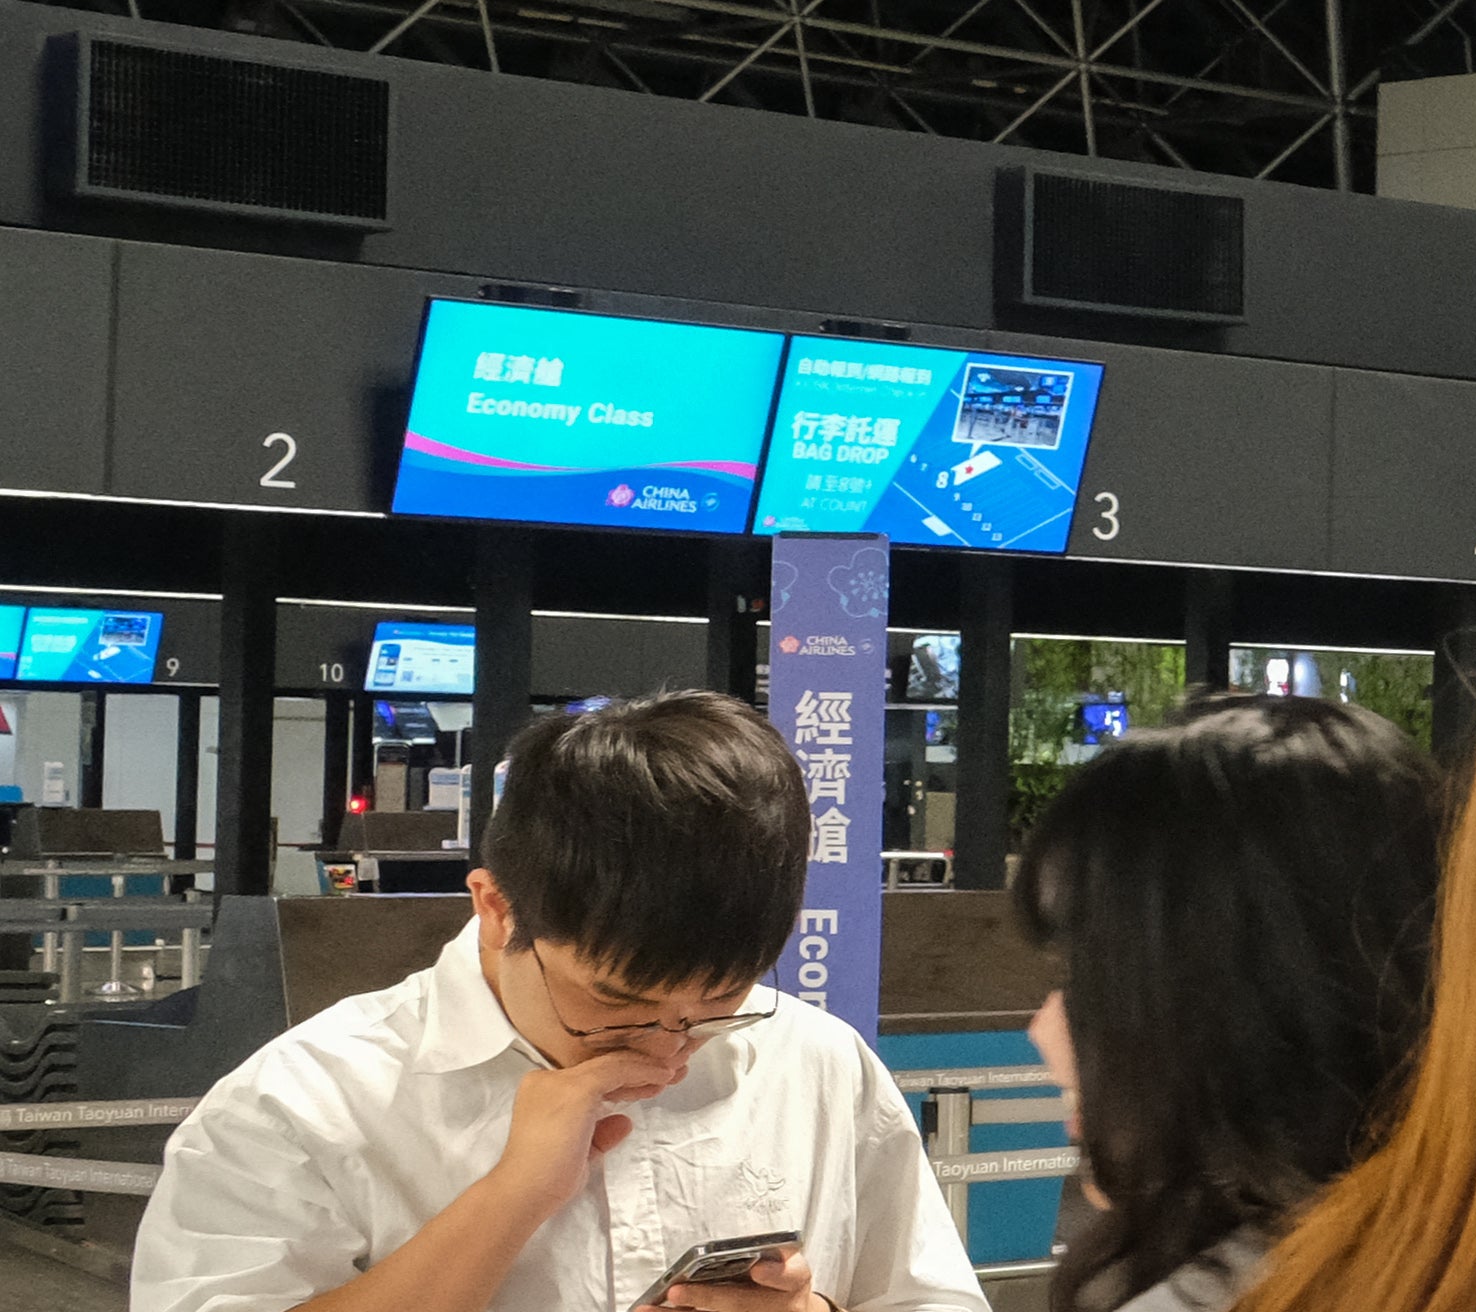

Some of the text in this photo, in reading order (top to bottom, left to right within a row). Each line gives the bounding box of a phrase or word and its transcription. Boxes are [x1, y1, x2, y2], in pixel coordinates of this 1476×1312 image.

[466, 392, 654, 427] Economy Class
[260, 432, 296, 488] 2
[792, 441, 890, 464] BAG DROP
[936, 471, 949, 488] 8
[642, 485, 690, 500] CHINA
[630, 498, 697, 513] AIRLINES
[1092, 492, 1120, 541] 3
[806, 635, 848, 646] CHINA
[799, 645, 856, 656] AIRLINES
[166, 658, 180, 677] 9
[319, 663, 344, 682] 10
[16, 1107, 73, 1123] Taiwan
[77, 1104, 144, 1124] Taoyuan
[933, 1160, 999, 1180] Taoyuan
